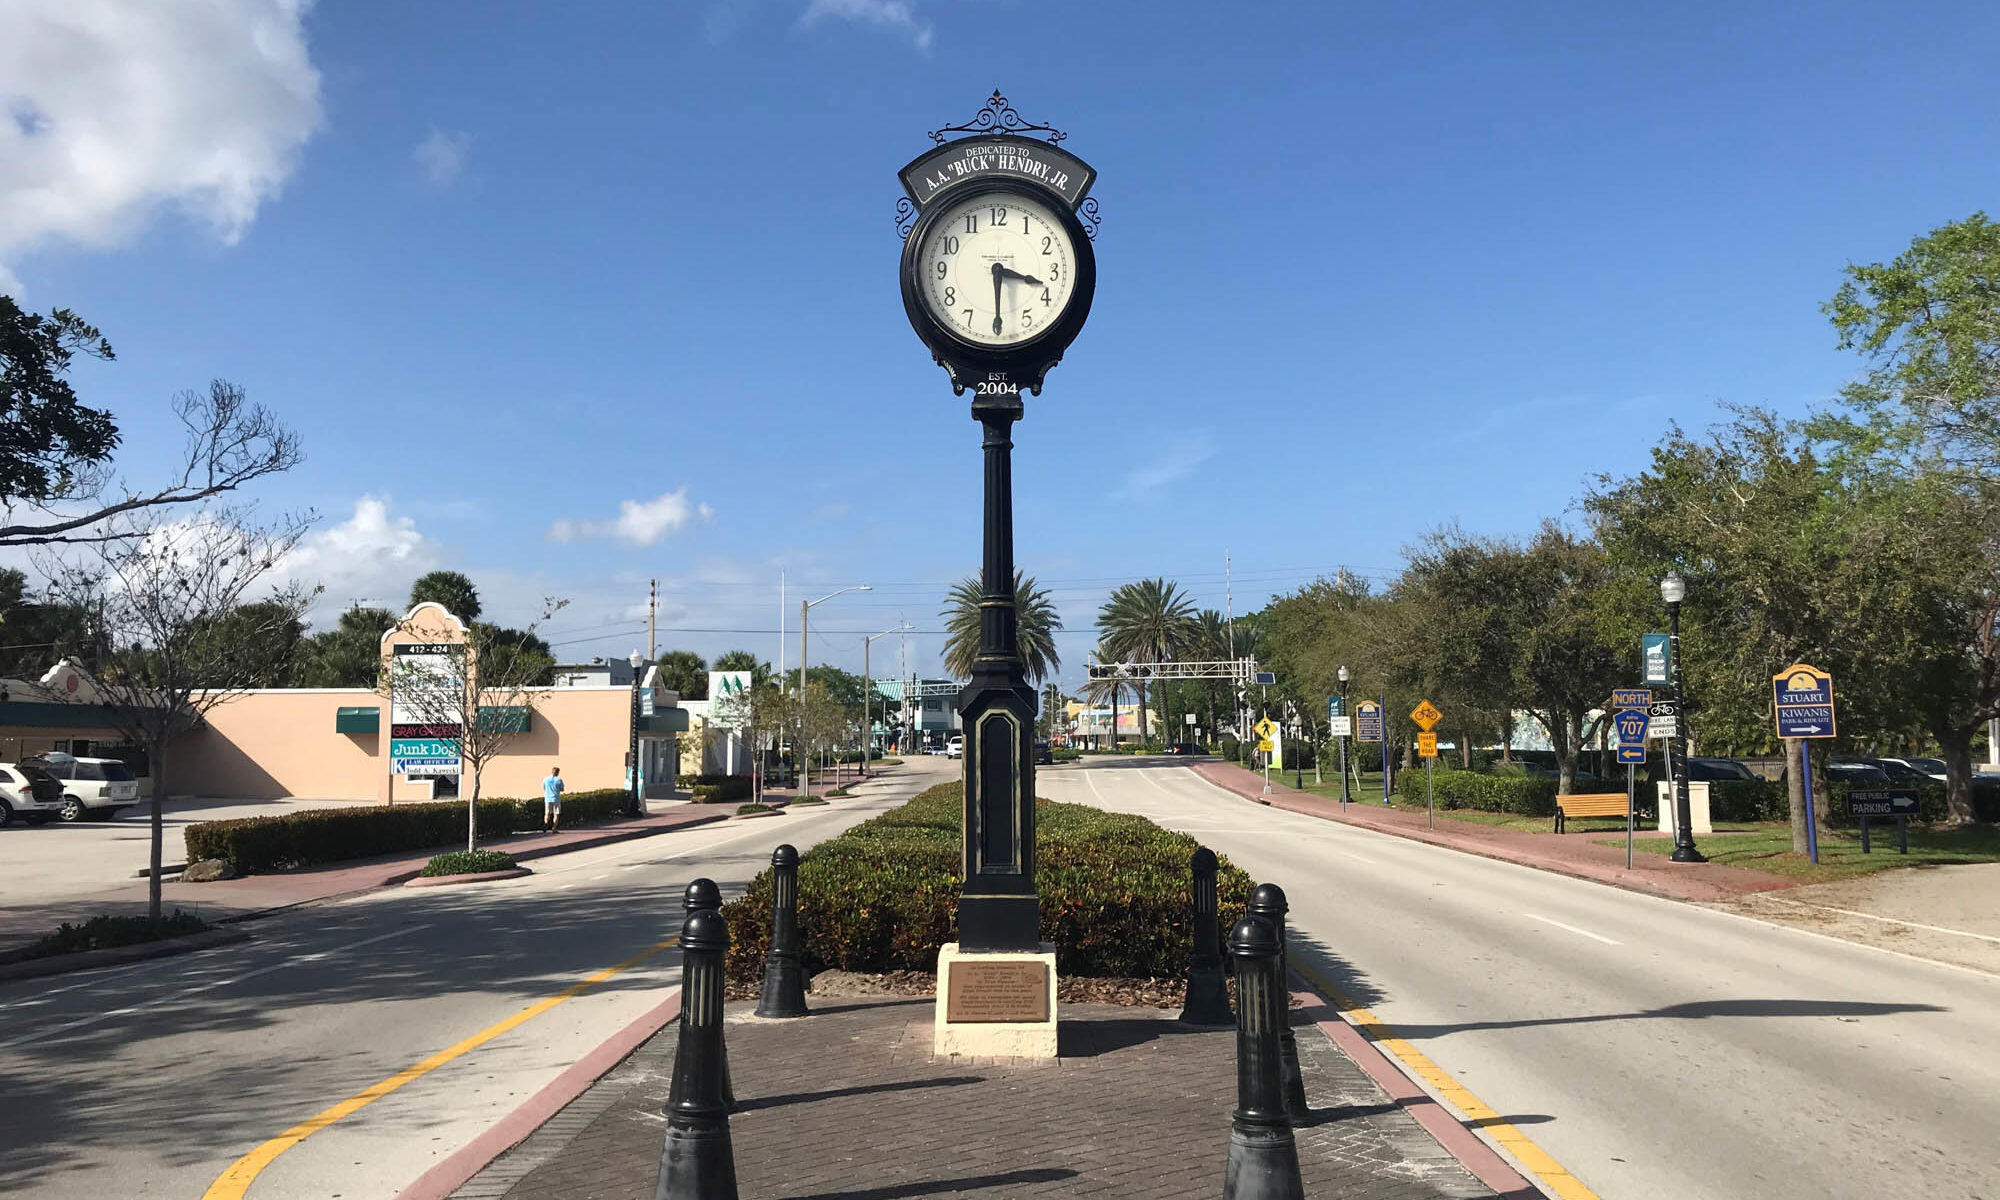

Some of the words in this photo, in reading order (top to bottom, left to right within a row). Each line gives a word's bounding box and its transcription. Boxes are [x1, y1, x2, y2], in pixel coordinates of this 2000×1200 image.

[965, 145, 1016, 158] DEDICATED
[1017, 147, 1030, 157] TO
[926, 169, 951, 191] A.A.
[948, 154, 995, 177] "BUCK"
[999, 154, 1053, 184] HENDRY,
[1050, 173, 1069, 191] JR.
[965, 214, 978, 234] 11
[990, 207, 1008, 227] 12
[1023, 216, 1030, 235] 1
[942, 236, 960, 255] 10
[1041, 236, 1053, 256] 2
[936, 261, 948, 281] 9
[1049, 262, 1060, 282] 3
[944, 286, 956, 307] 8
[1040, 287, 1052, 308] 4
[962, 308, 974, 329] 7
[1021, 308, 1033, 329] 5
[988, 372, 1008, 381] EST.
[977, 382, 1018, 395] 2004
[409, 645, 425, 654] 412
[431, 645, 448, 654] 424
[1615, 693, 1650, 705] NORTH
[1782, 693, 1825, 703] STUART
[1781, 708, 1829, 718] KIWANIS
[392, 726, 417, 737] GRAY
[418, 725, 460, 737] GARDENS
[1620, 721, 1644, 735] 707
[394, 744, 428, 755] Junk
[431, 744, 457, 758] Dog
[1853, 802, 1890, 813] PARKING
